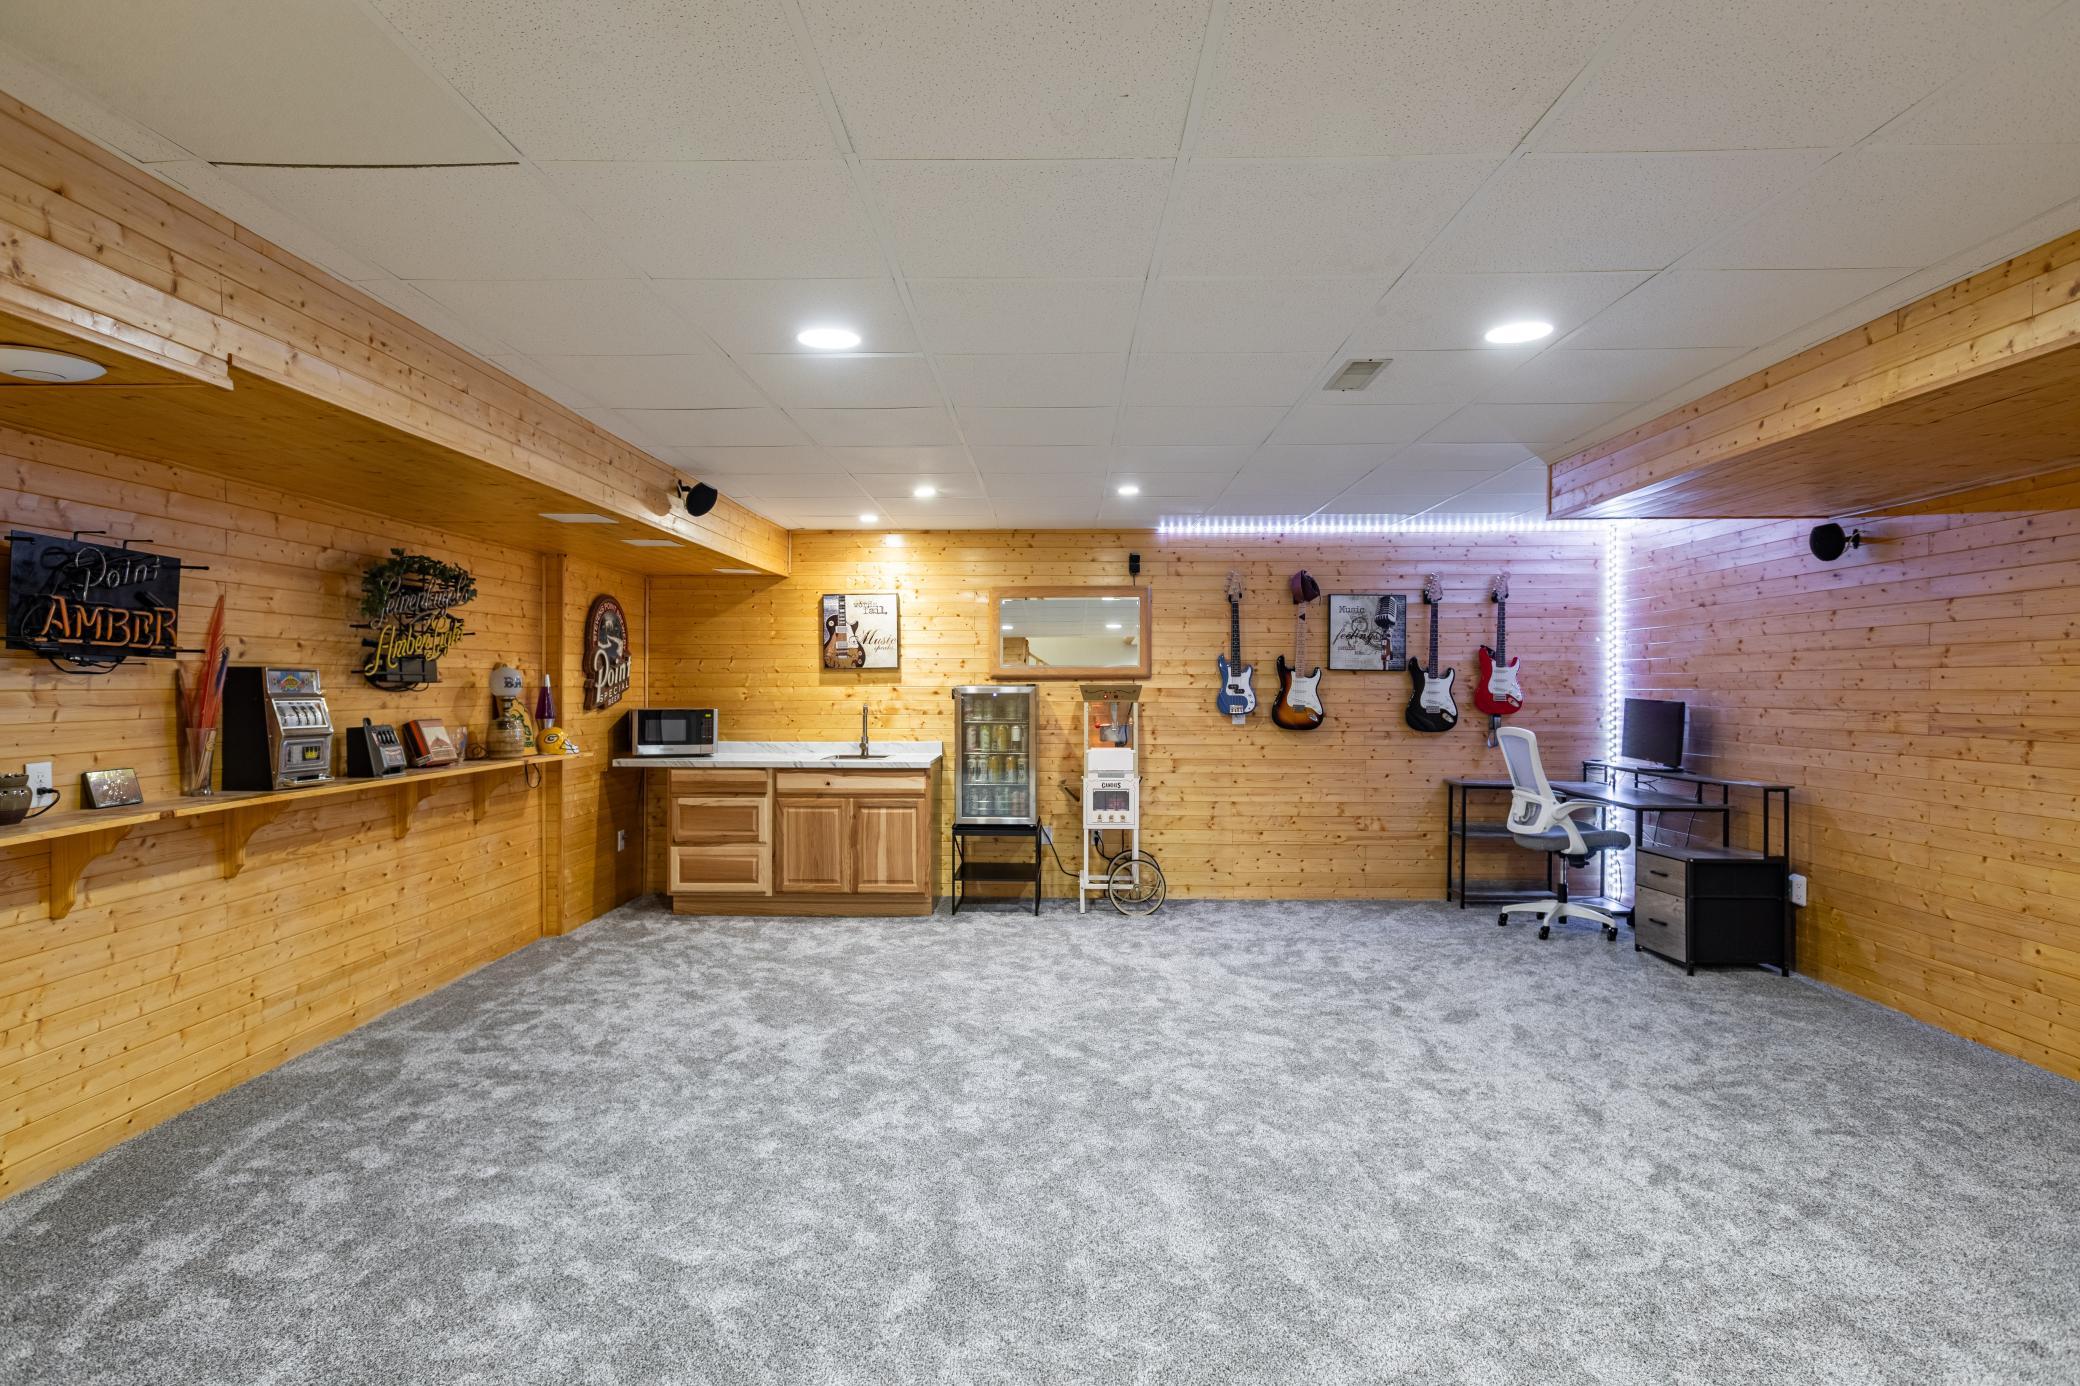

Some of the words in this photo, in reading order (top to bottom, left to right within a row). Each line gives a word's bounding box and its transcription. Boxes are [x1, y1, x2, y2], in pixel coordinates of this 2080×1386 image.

[73, 546, 162, 602] Point
[34, 594, 183, 650] AMBER
[364, 624, 432, 676] Amber
[593, 648, 632, 704] Point
[503, 676, 523, 688] BA
[599, 681, 629, 703] SPECIAL
[607, 693, 622, 706] BEER
